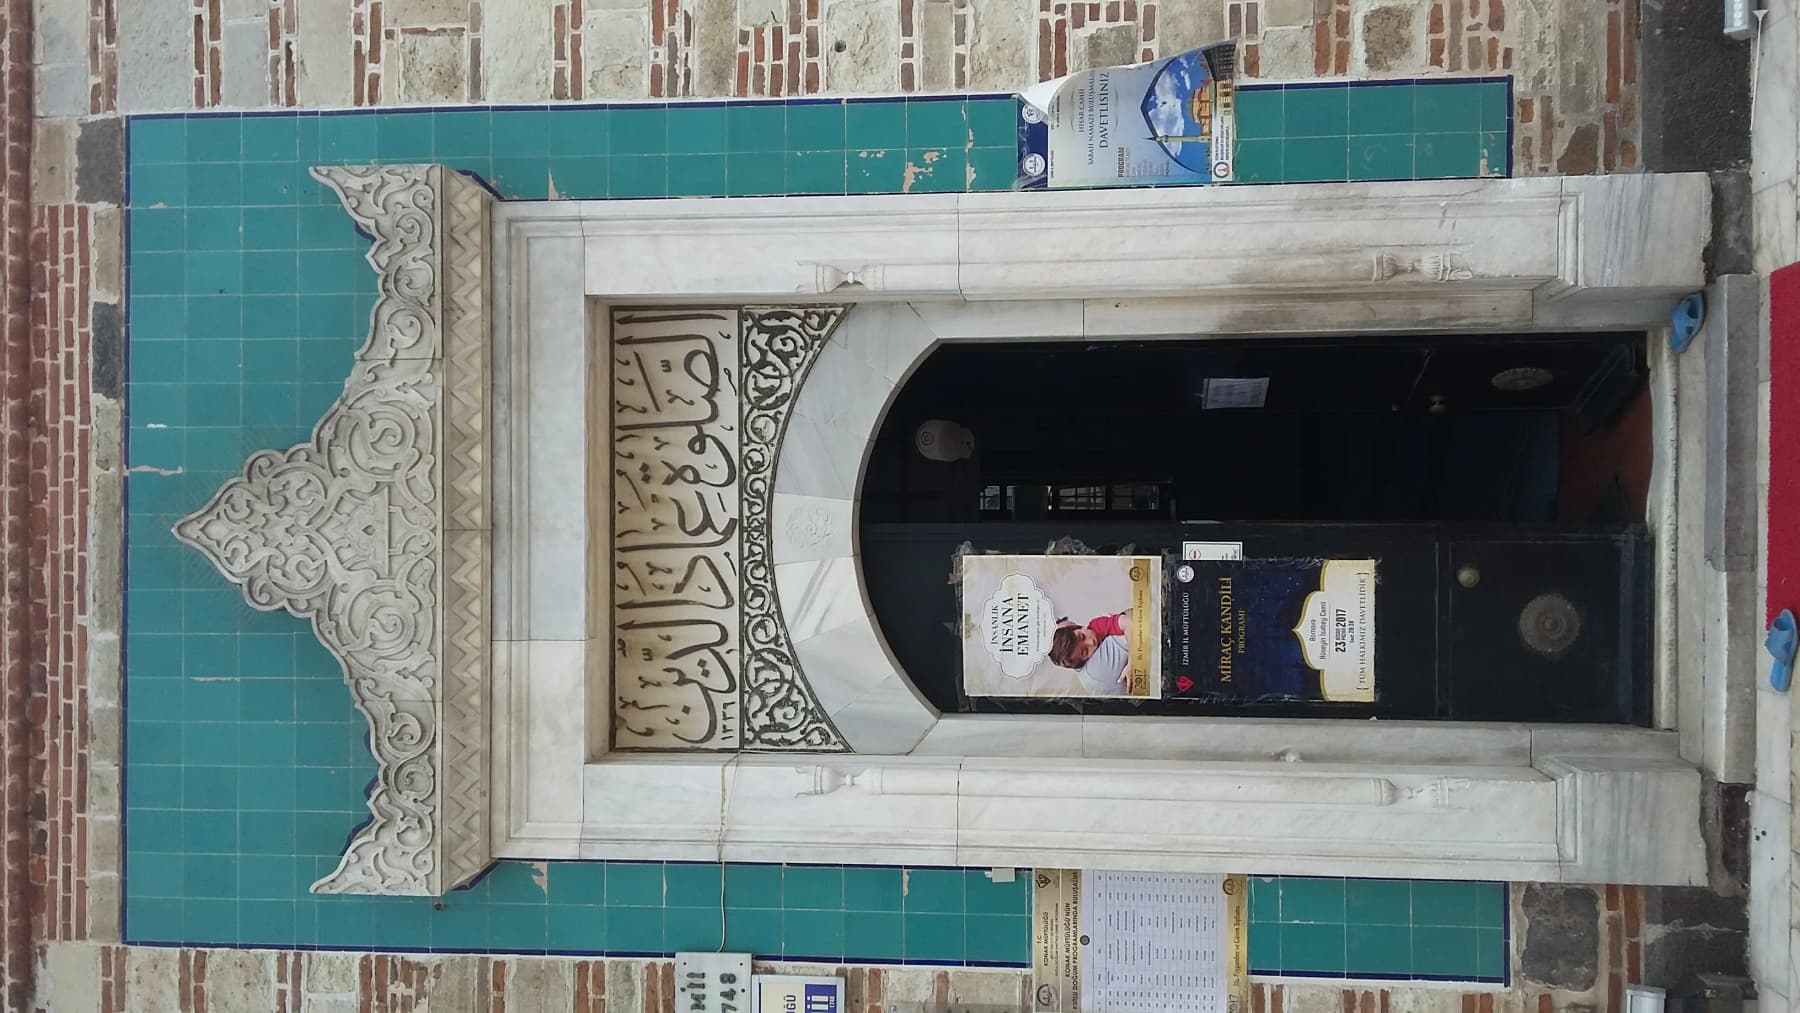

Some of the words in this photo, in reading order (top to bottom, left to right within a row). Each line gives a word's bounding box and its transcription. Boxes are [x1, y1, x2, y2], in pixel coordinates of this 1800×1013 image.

[990, 605, 998, 644] İNSANLIK
[1017, 592, 1028, 656] EMANET
[1218, 576, 1232, 634] KANDİLİ
[1336, 608, 1346, 627] 2017
[999, 597, 1013, 654] İNSANA
[1238, 610, 1246, 654] PROGRAMI
[1180, 645, 1190, 666] İZMİR
[1218, 637, 1235, 682] MİRAÇ
[1335, 642, 1346, 652] 23
[1134, 669, 1143, 689] 2017
[783, 994, 796, 1013] ĞÜ
